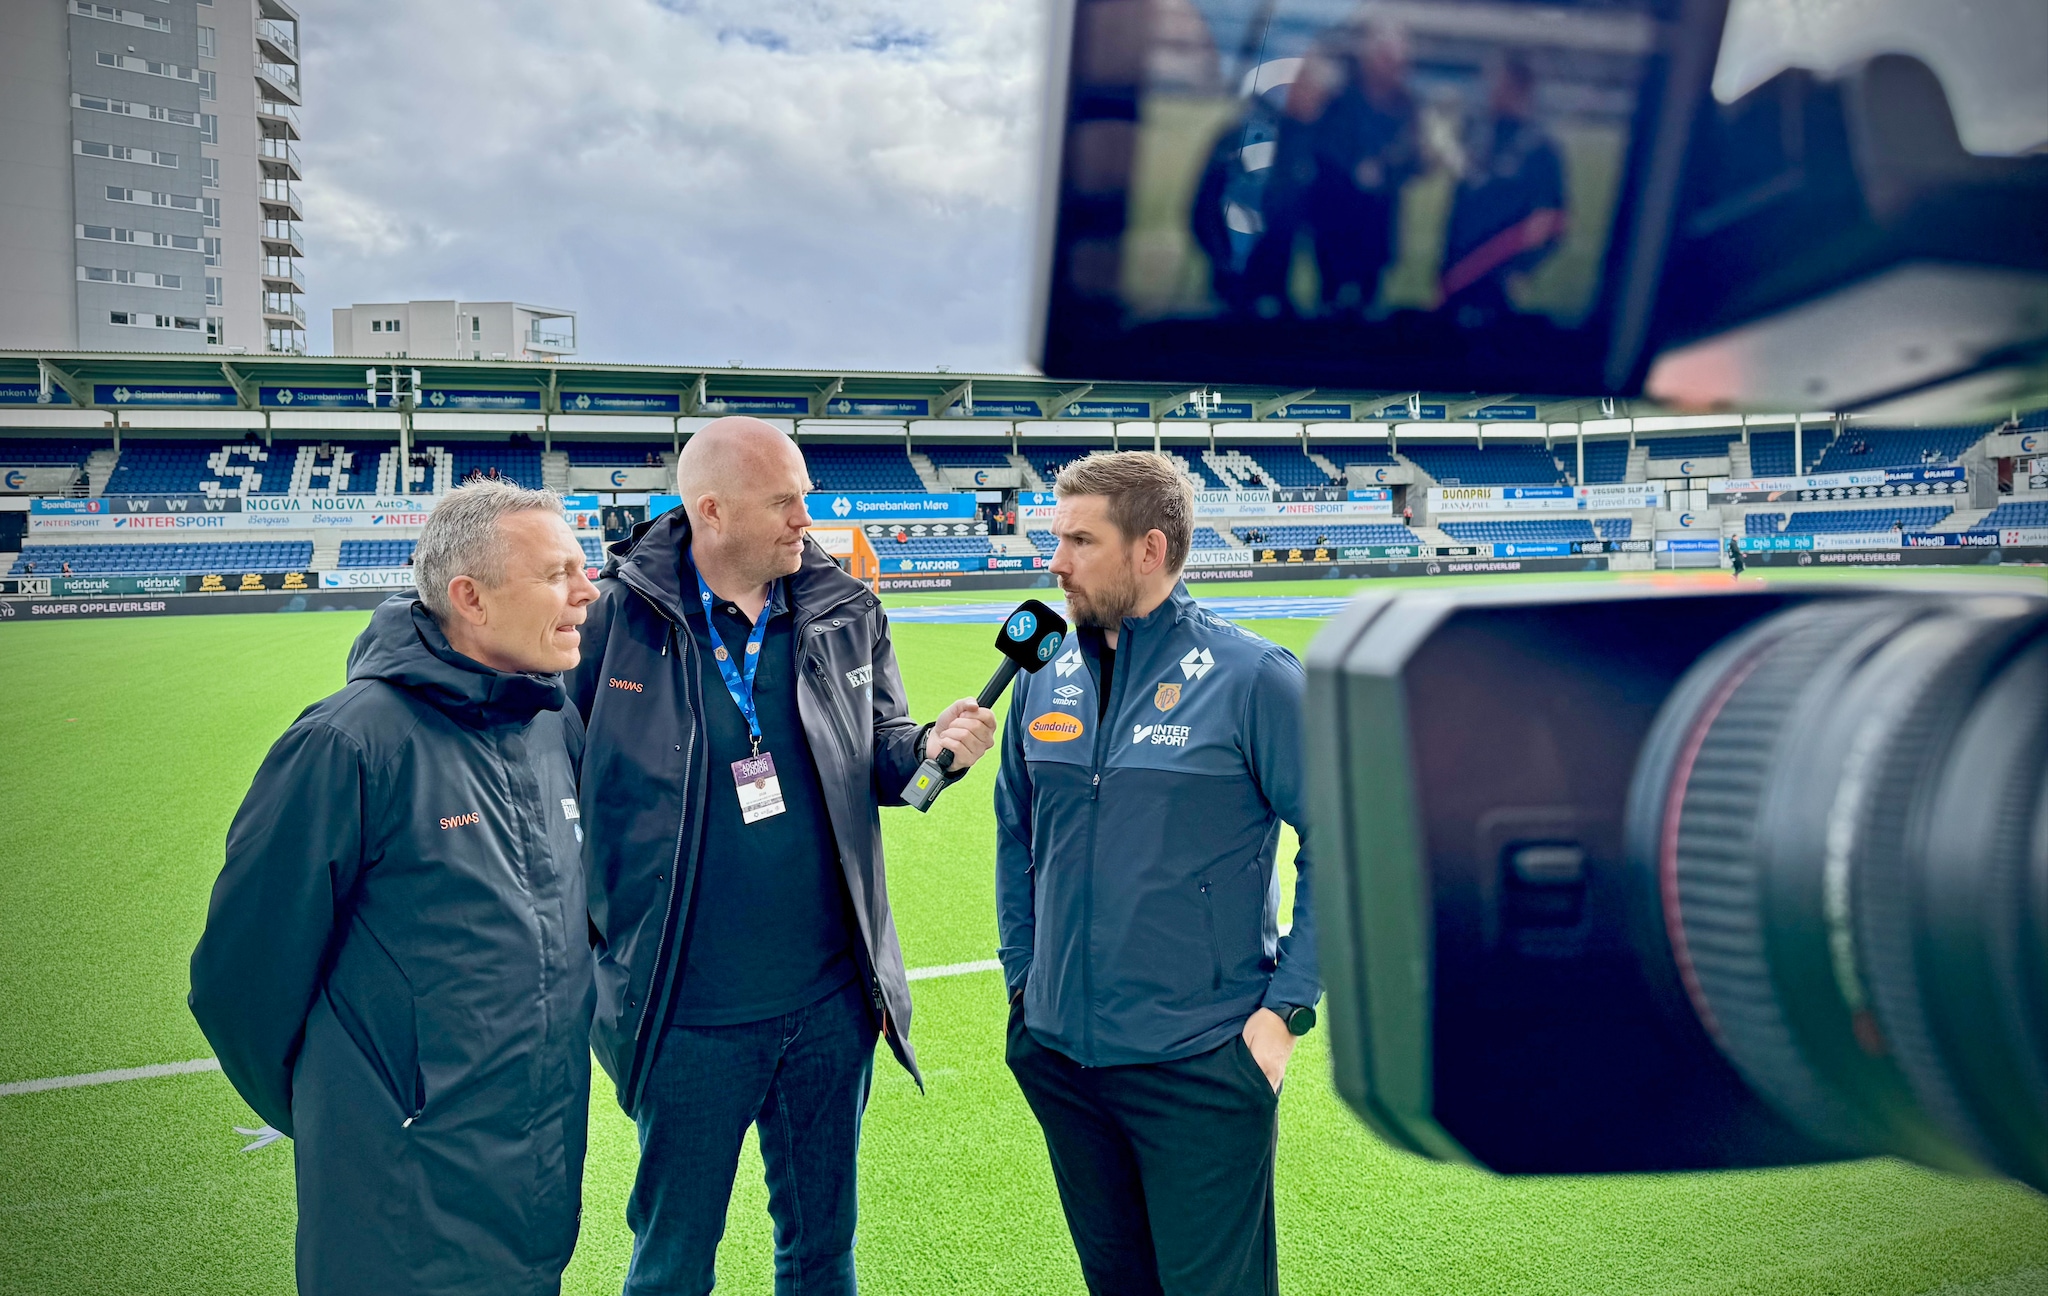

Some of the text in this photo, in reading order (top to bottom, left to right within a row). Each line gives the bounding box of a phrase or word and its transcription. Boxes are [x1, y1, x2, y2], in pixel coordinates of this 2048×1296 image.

[297, 393, 353, 402] Sparebanken
[1593, 487, 1625, 495] VEGSUND
[1725, 481, 1792, 490] Storm Elektro
[1194, 493, 1229, 503] NOGVA
[1236, 492, 1271, 502] NOGVA
[1592, 497, 1641, 509] gtravel.no
[41, 501, 86, 510] SpareBank
[246, 499, 301, 510] NOGVA
[312, 498, 365, 510] NOGVA
[375, 500, 403, 509] Auto
[856, 499, 949, 513] Sparebanken Møre
[1286, 504, 1344, 514] INTERSPORT
[43, 519, 100, 527] INTERSPORT
[129, 516, 225, 528] INTERSPORT
[248, 514, 290, 527] Bergans
[312, 513, 353, 526] Bergans
[1622, 540, 1650, 552] assist
[1753, 537, 1771, 549] DNB
[1775, 537, 1791, 548] DNB
[1795, 536, 1811, 548] DNB
[1868, 537, 1899, 545] FARSTAD
[1918, 536, 1946, 547] Medi3
[1968, 534, 1998, 546] Medi3
[1581, 542, 1604, 552] assist
[914, 559, 960, 570] TAFJORD
[892, 579, 952, 589] OPPLEVERLSER
[31, 602, 166, 615] SKAPER OPPLEVERLSER
[609, 678, 644, 693] SWIMS
[1052, 698, 1078, 706] umbro
[1033, 721, 1078, 734] Sundolitt
[1153, 724, 1191, 737] INTER
[1151, 734, 1188, 747] SPORT
[742, 758, 767, 772] ADGANG
[743, 763, 769, 778] STADION
[440, 812, 480, 830] SWIMS
